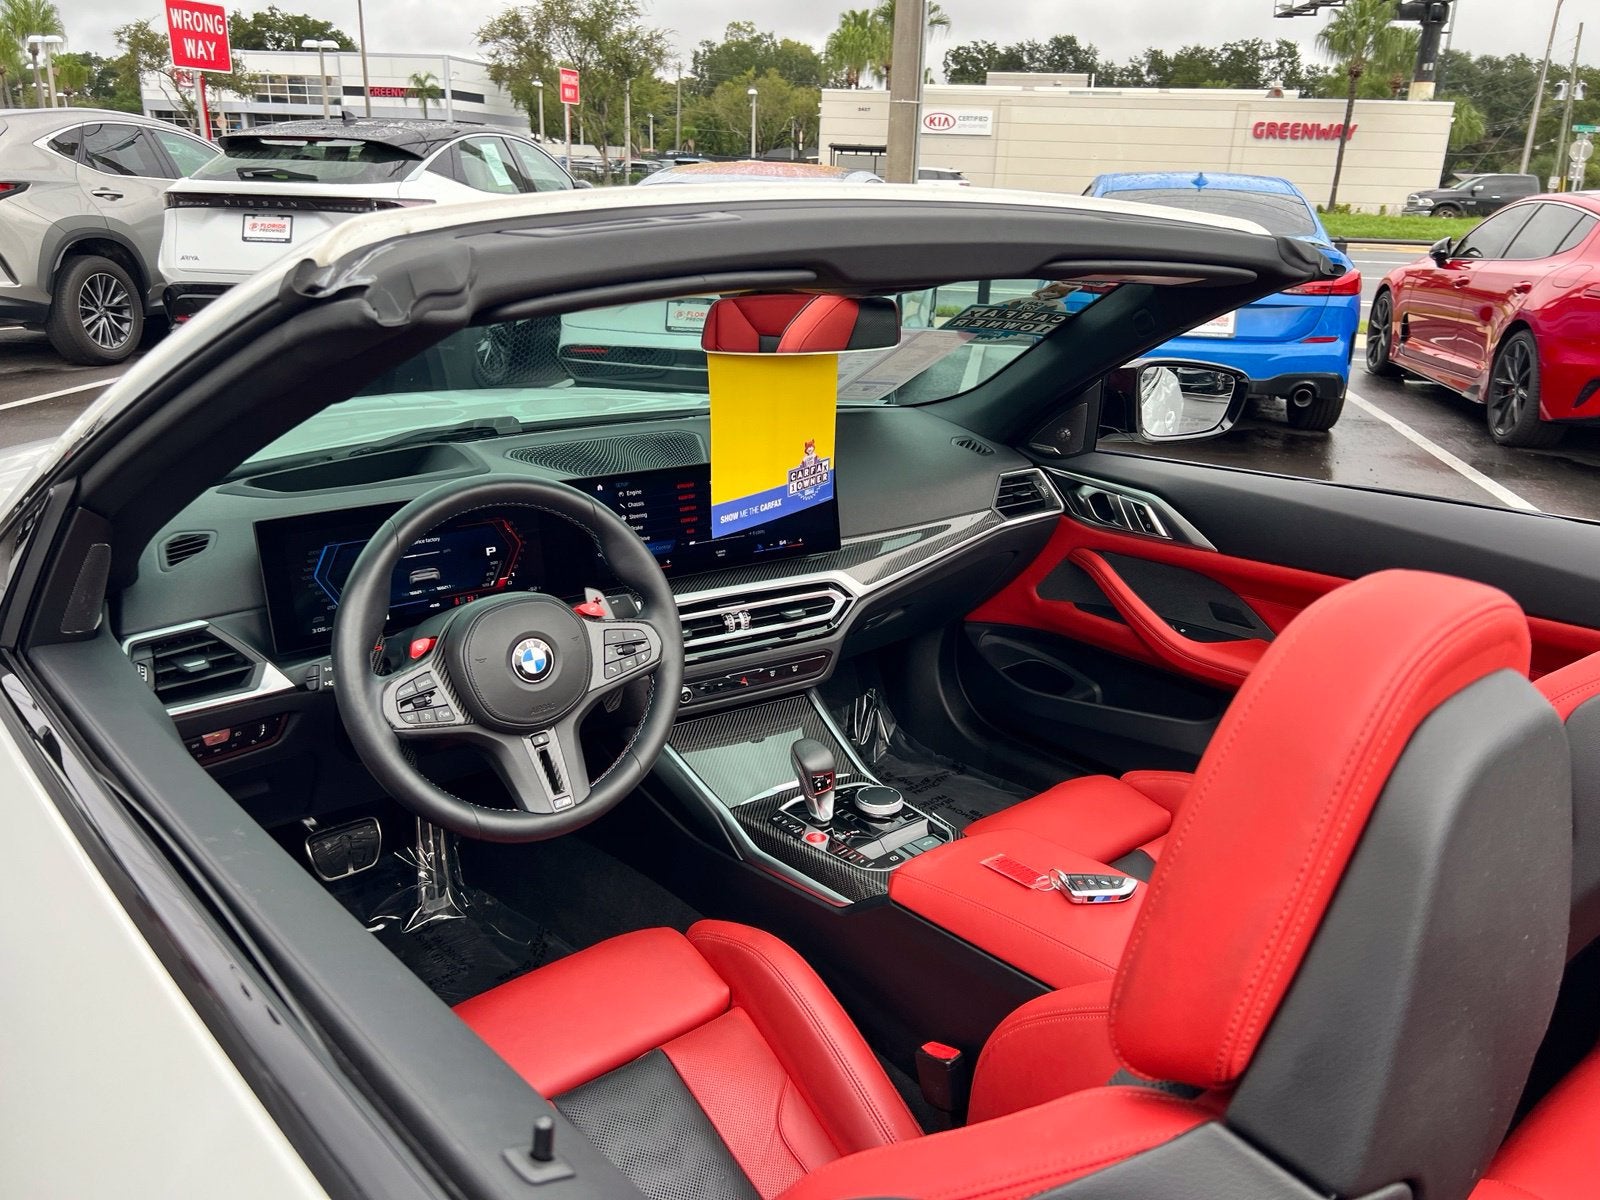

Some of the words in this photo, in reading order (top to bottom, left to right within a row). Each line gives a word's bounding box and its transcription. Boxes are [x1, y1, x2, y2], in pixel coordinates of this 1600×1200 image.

[170, 7, 224, 35] WRONG
[184, 37, 216, 61] WAY
[929, 117, 950, 127] KIA
[1253, 122, 1358, 140] GREENWAY
[791, 463, 829, 481] CARFAX
[797, 473, 828, 490] OWNER
[626, 489, 642, 497] Engine
[629, 512, 648, 520] Steering
[720, 512, 739, 524] SHOW
[739, 509, 748, 518] ME
[749, 506, 759, 515] THE
[760, 498, 783, 512] CARFAX
[425, 536, 441, 544] factory
[485, 546, 497, 557] P
[516, 640, 548, 657] BMW
